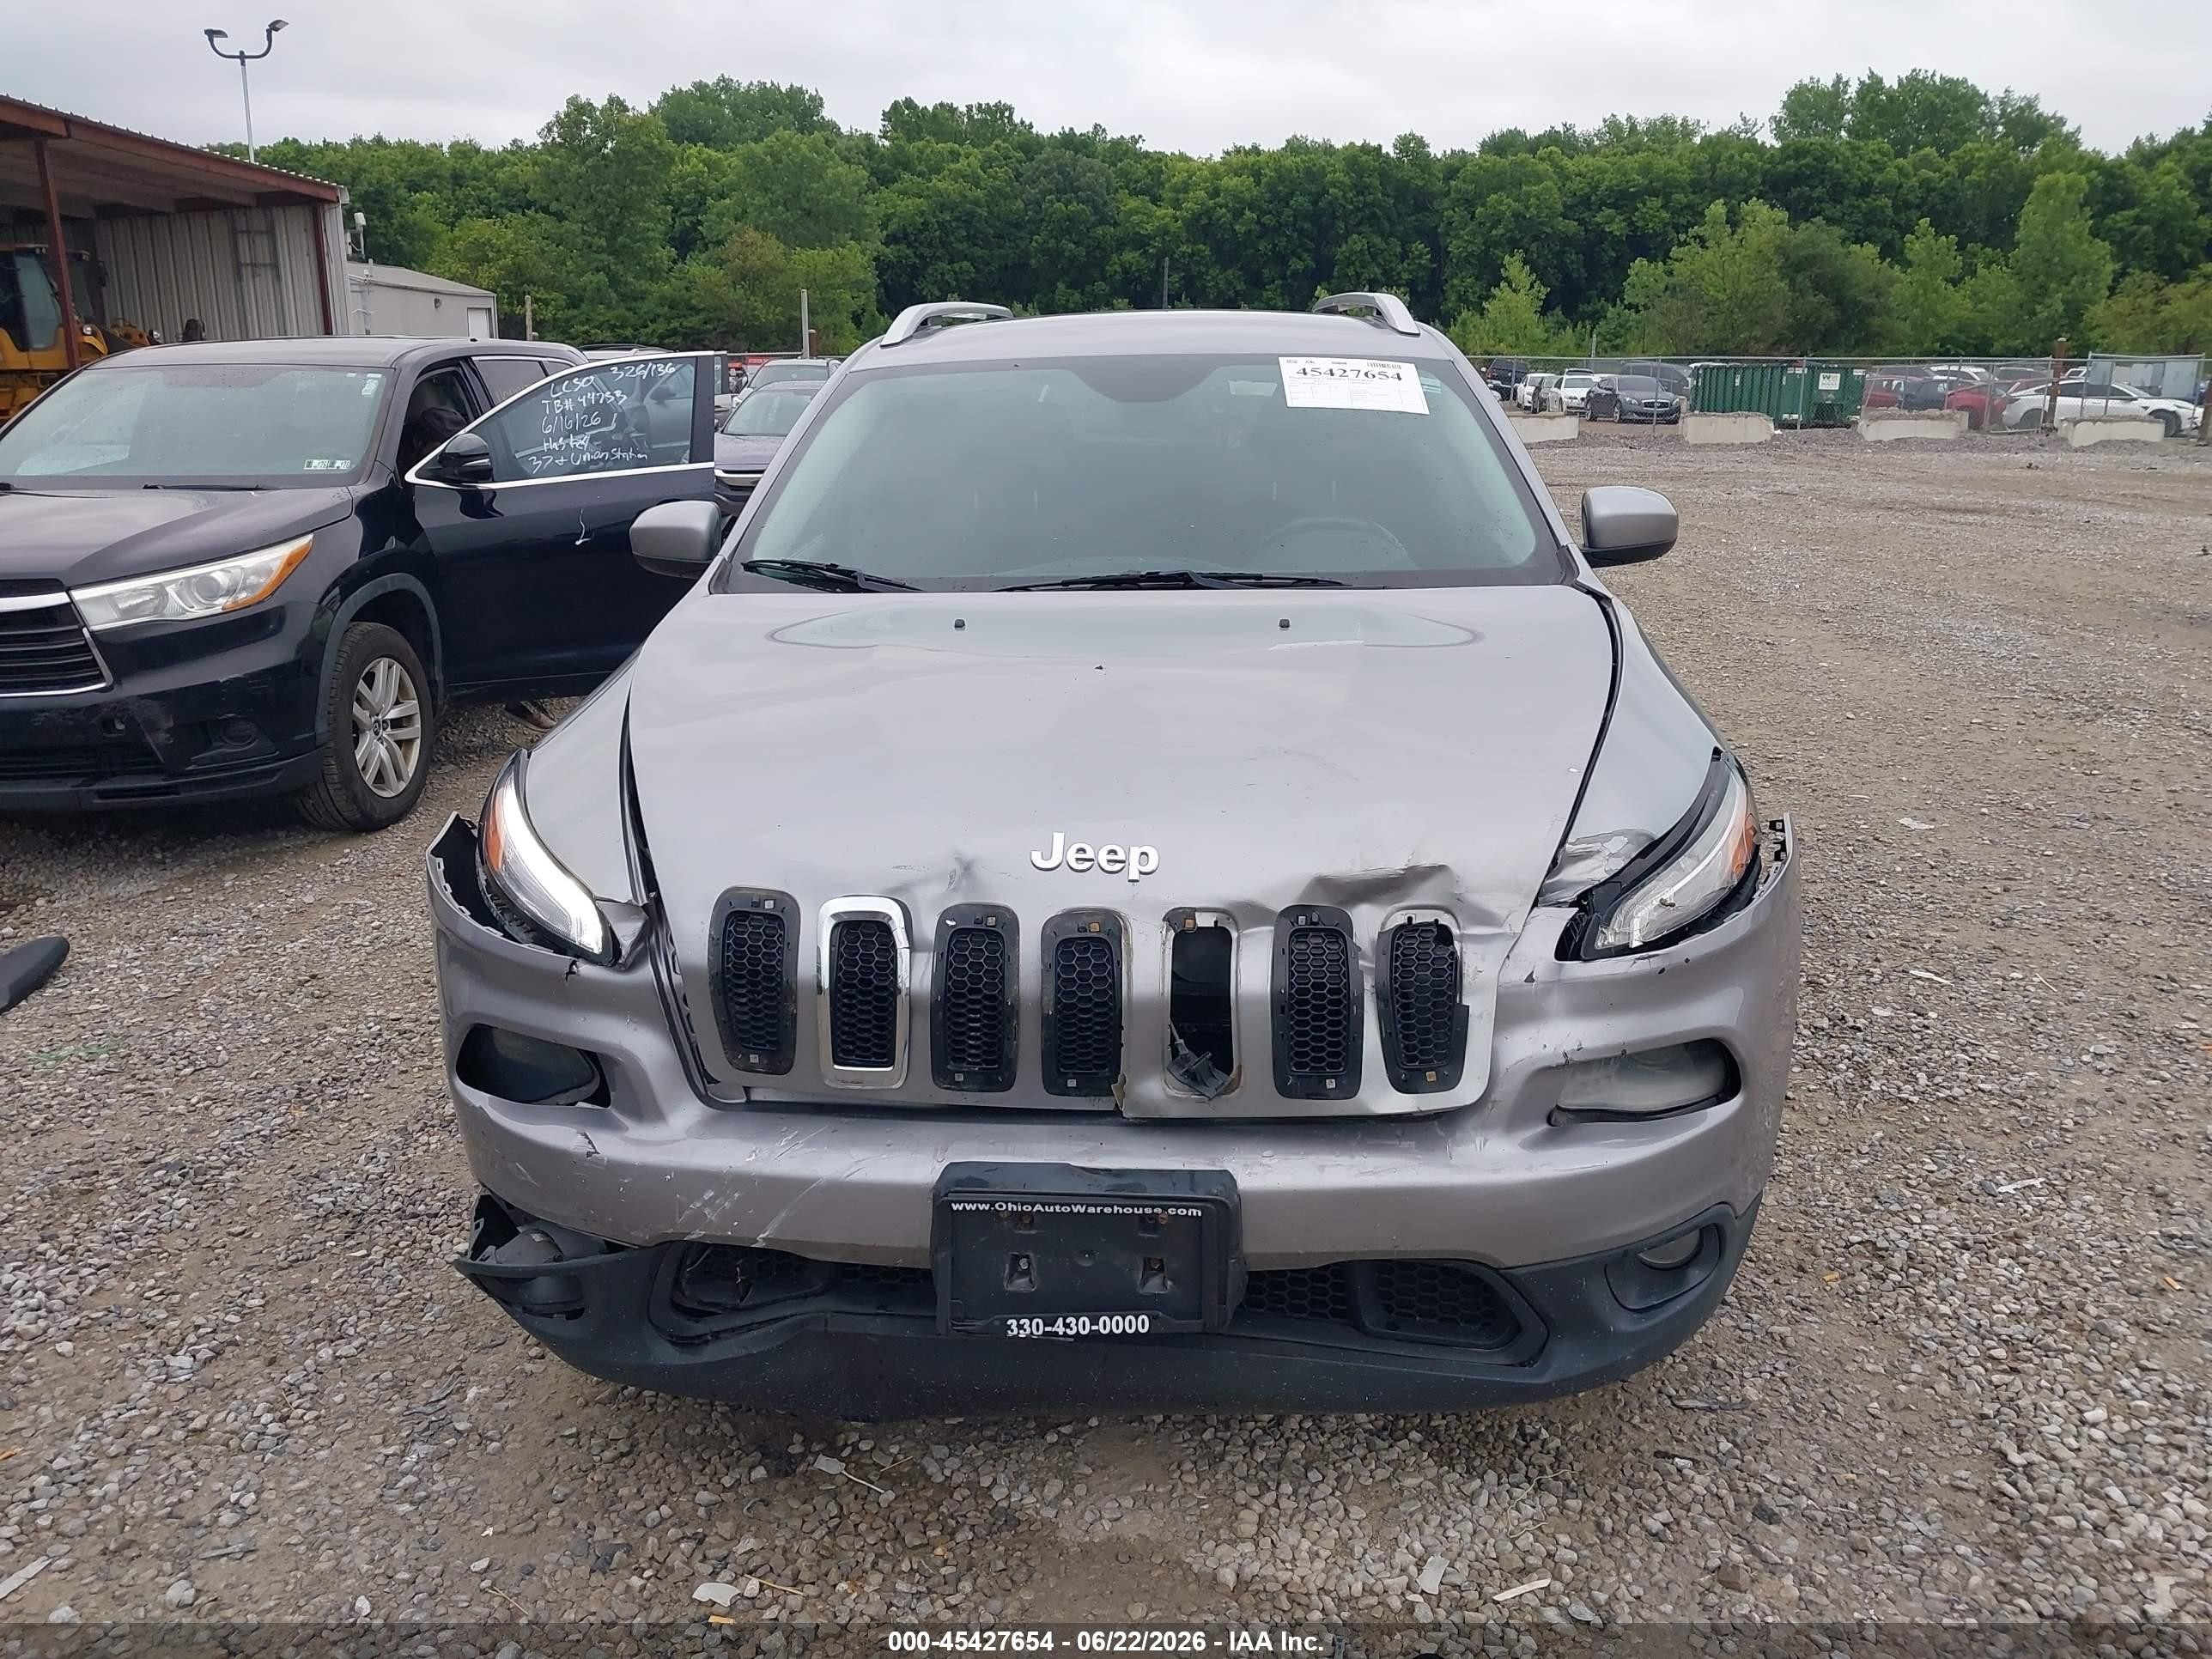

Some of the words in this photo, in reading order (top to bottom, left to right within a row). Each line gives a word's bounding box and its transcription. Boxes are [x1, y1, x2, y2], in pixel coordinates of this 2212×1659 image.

[1296, 367, 1403, 381] 45427654
[550, 375, 596, 398] LCSO
[541, 411, 602, 434] 6/16/26
[1030, 831, 1160, 883] Jeep
[951, 1201, 1202, 1218] www.OhioAutoWarehouse.com
[1006, 1314, 1151, 1338] 330-430-0000
